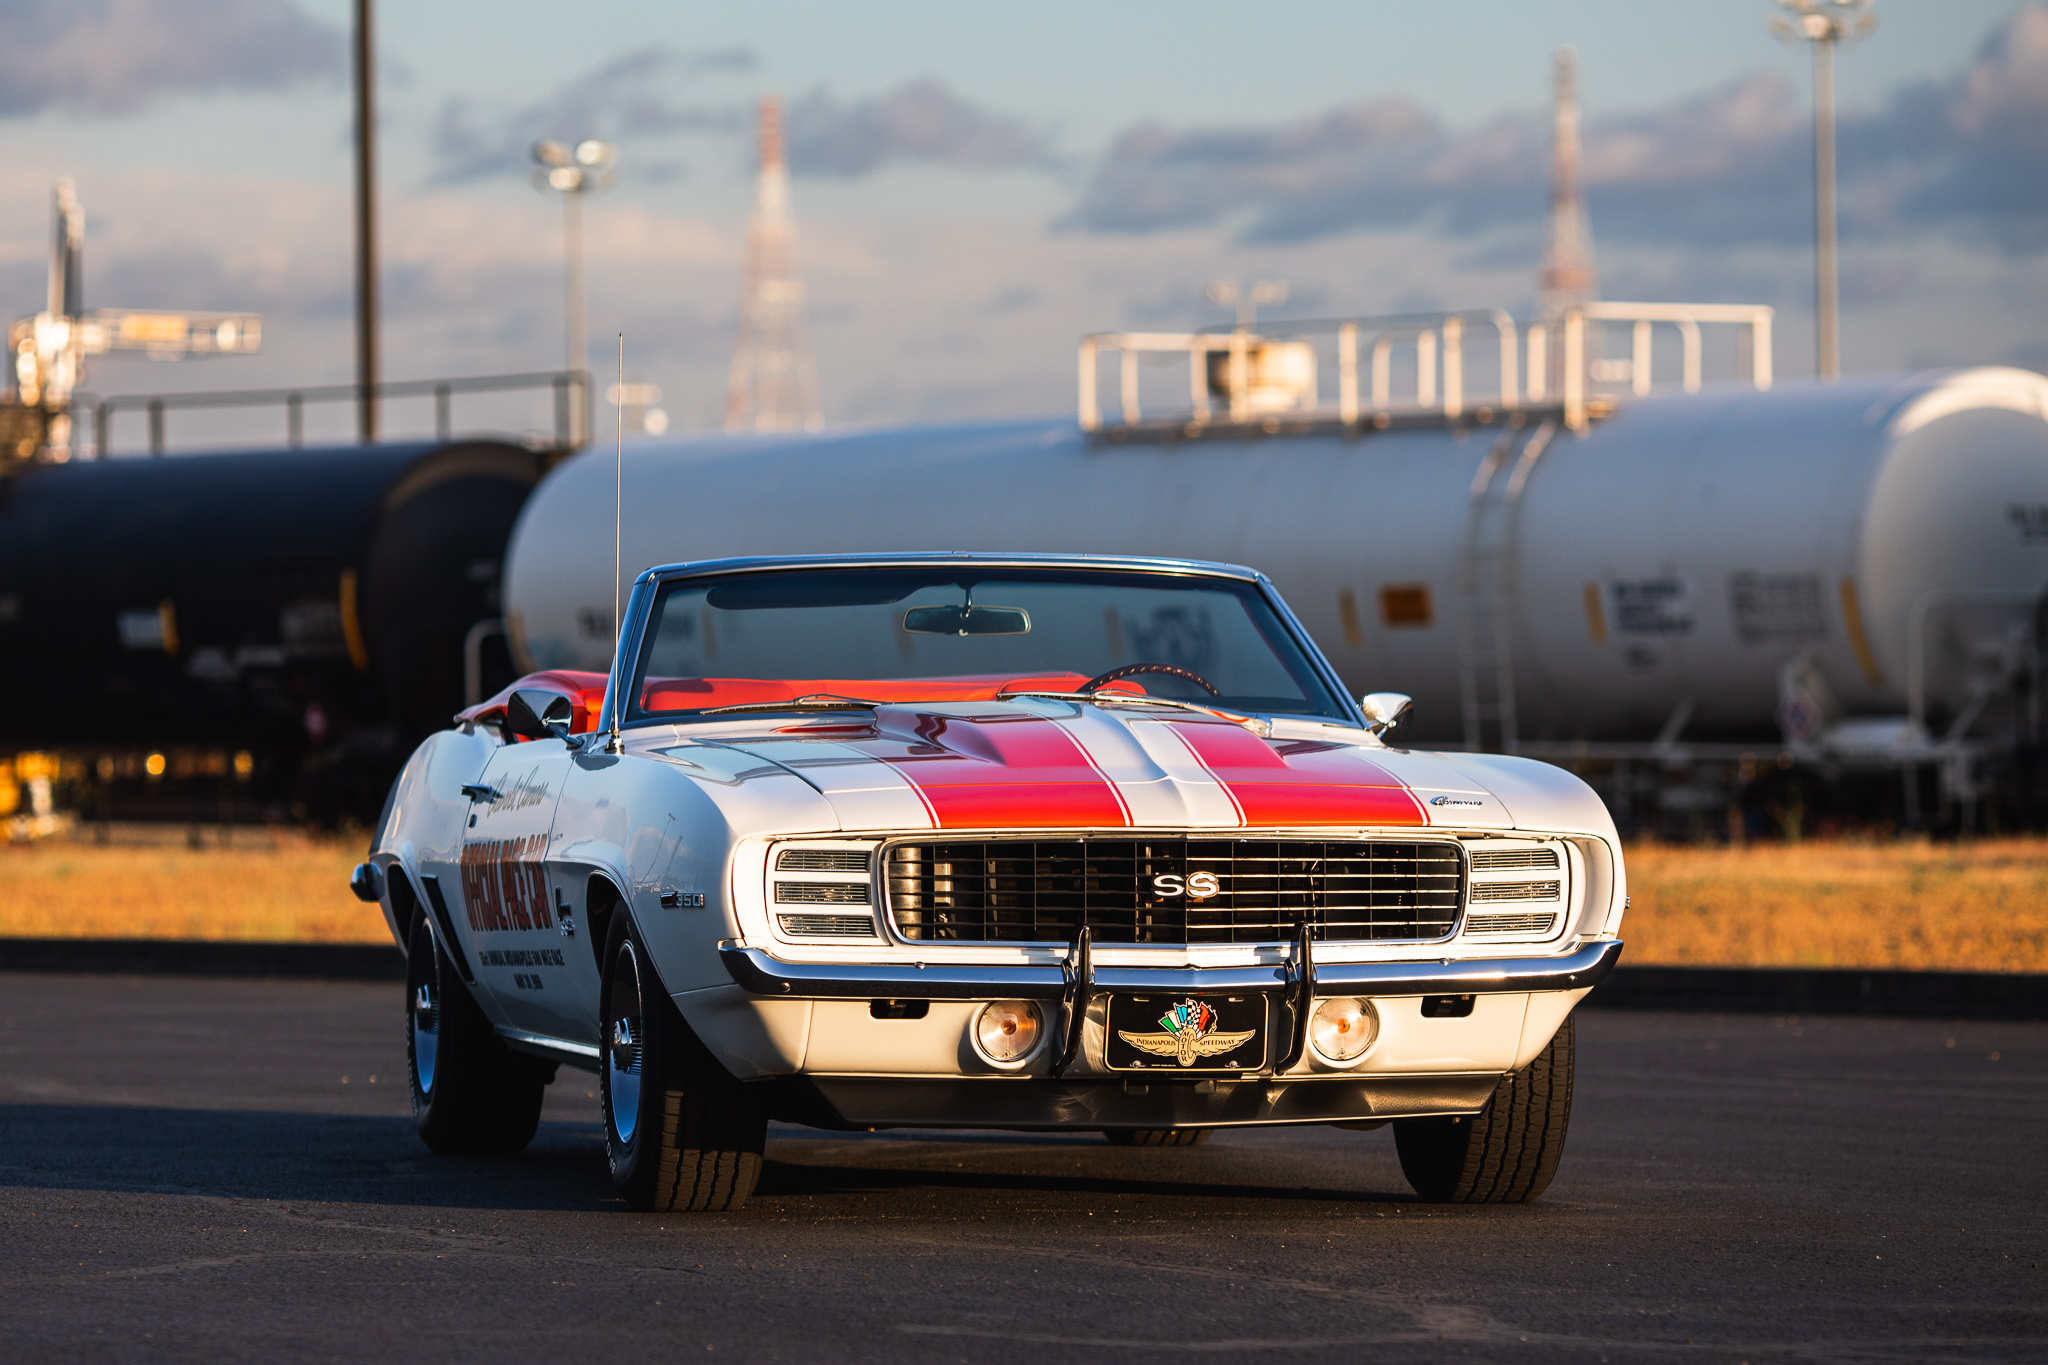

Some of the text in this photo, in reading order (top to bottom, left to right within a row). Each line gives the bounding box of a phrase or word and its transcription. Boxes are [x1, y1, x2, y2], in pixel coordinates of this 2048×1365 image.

[460, 834, 553, 932] OFFICIAL PACE CAR
[1152, 871, 1220, 898] SS
[675, 893, 701, 907] 350
[1136, 1038, 1177, 1046] INDIANAPOLIS
[1180, 1031, 1190, 1062] MOTOR
[1199, 1038, 1236, 1046] SPEEDWAY
